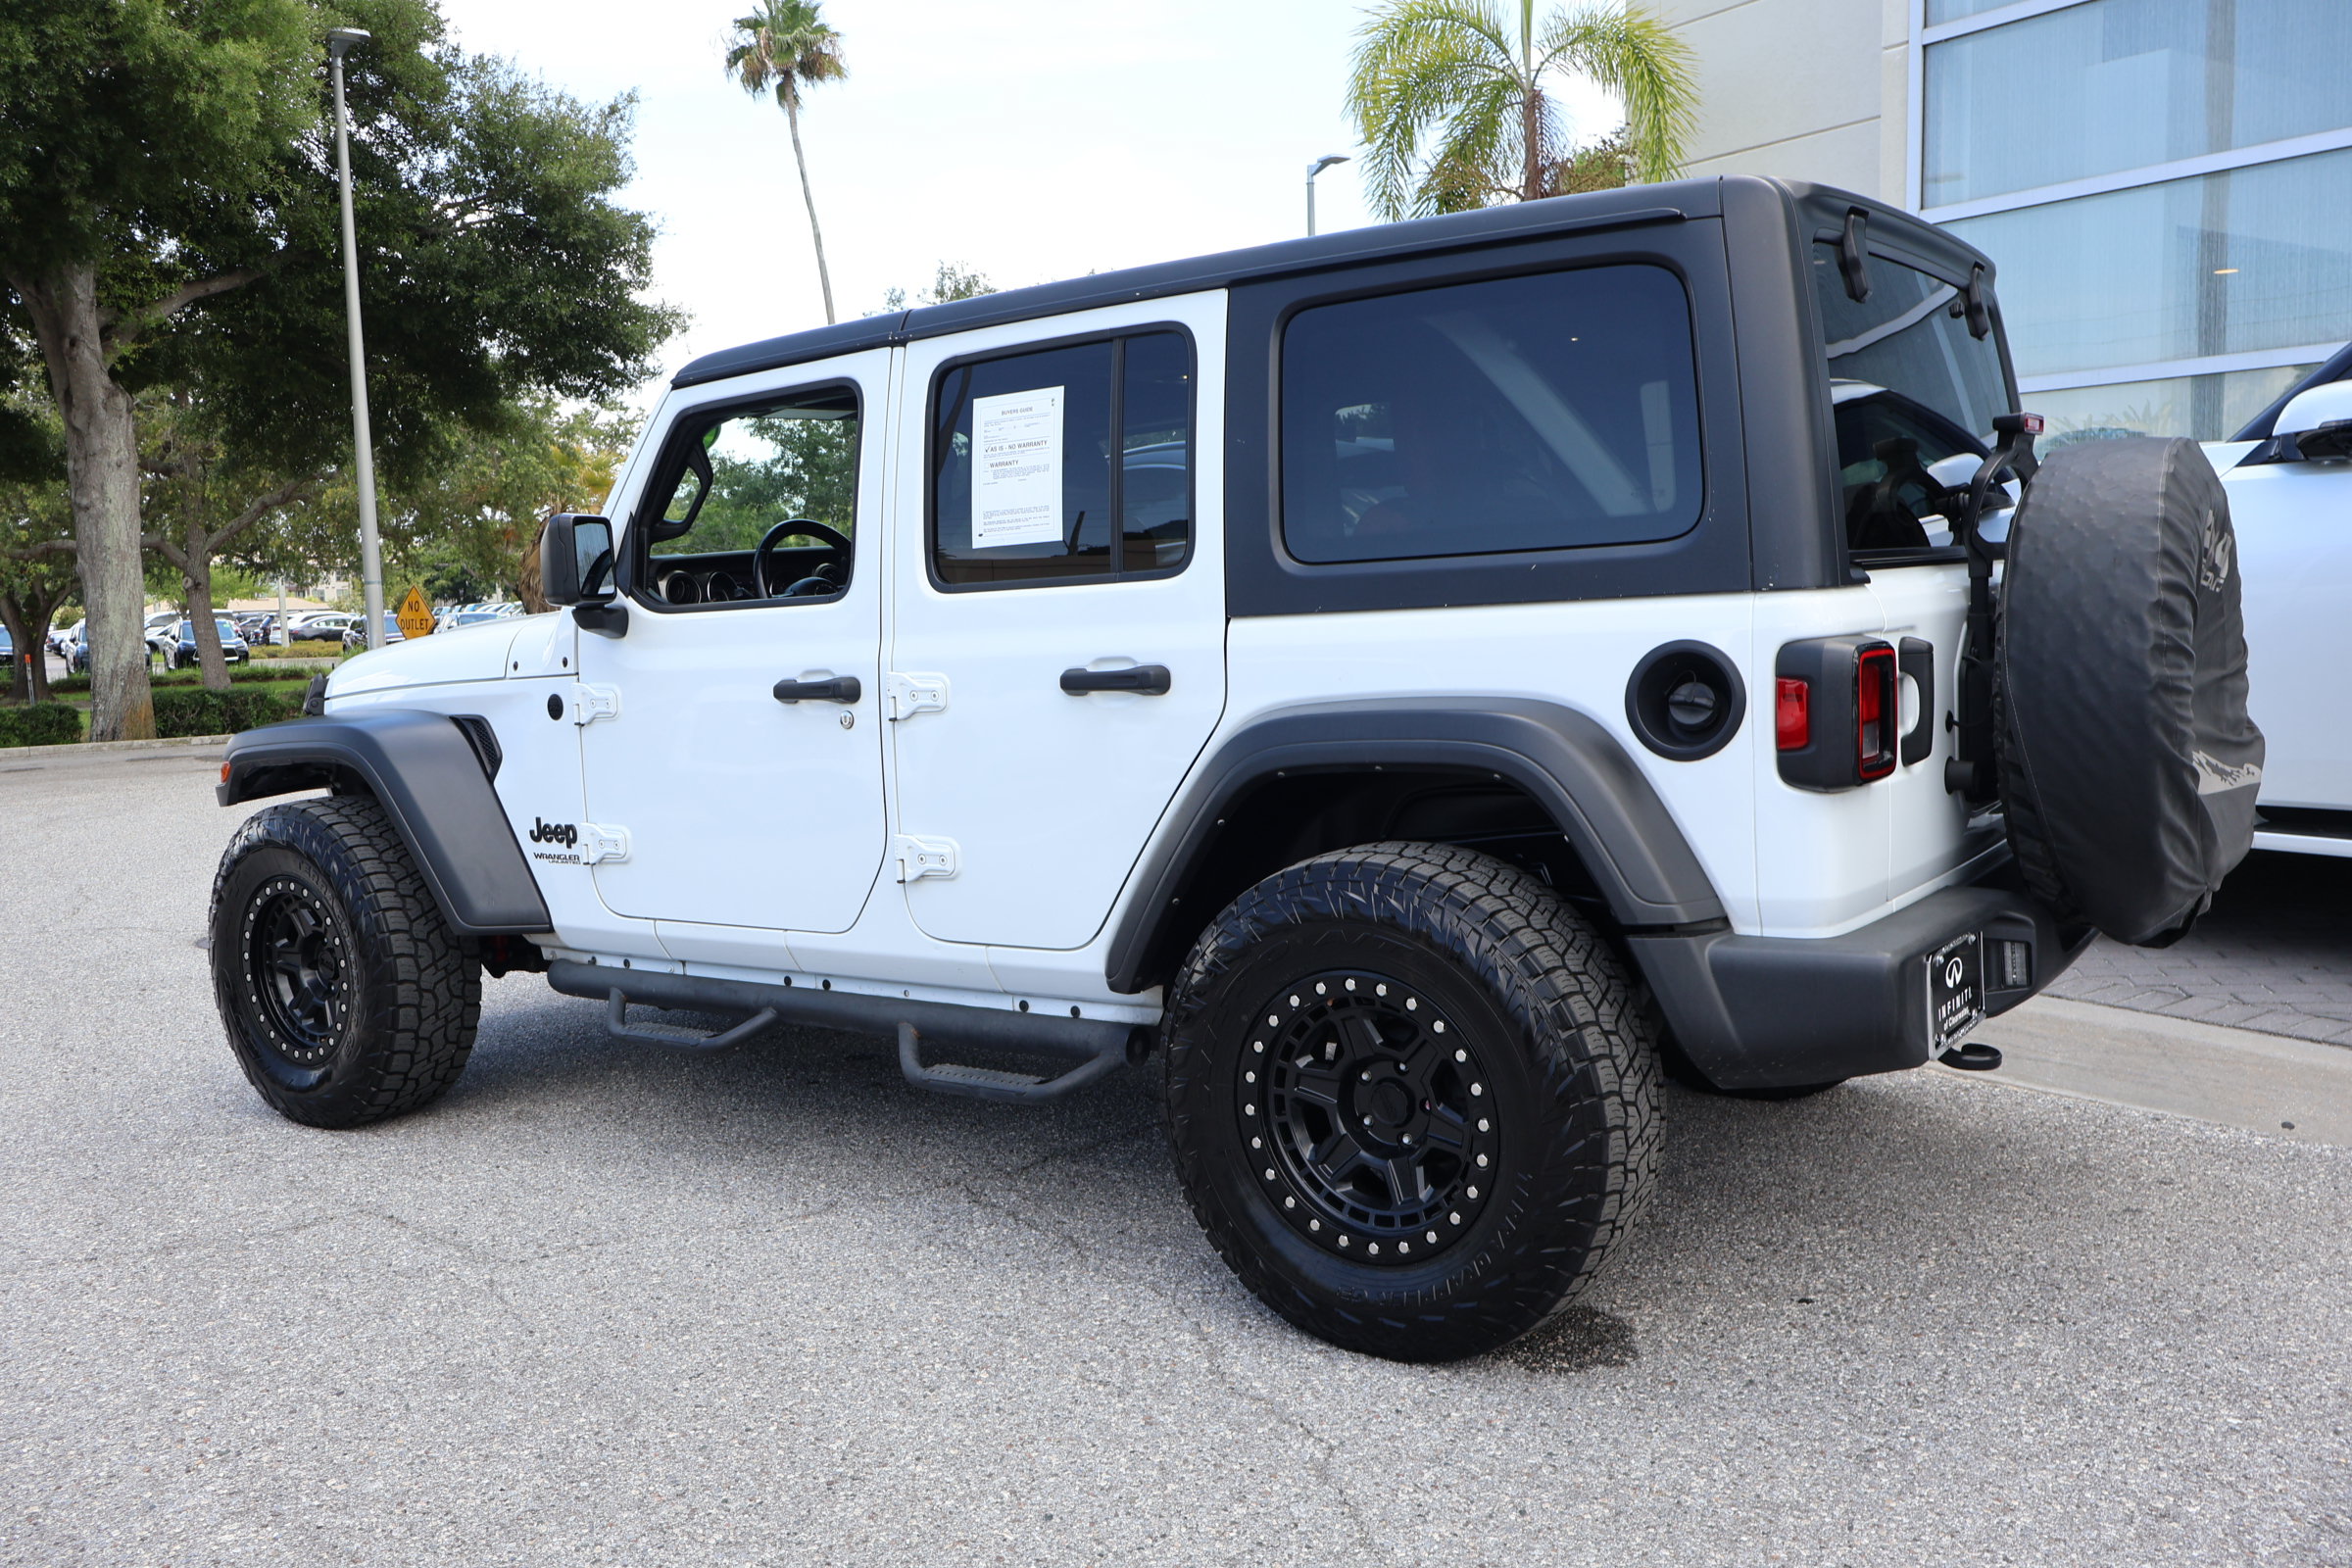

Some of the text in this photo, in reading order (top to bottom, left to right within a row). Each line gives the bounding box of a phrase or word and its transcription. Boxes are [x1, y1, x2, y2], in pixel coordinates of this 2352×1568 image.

[1018, 440, 1047, 449] WARRANTY
[990, 459, 1019, 468] WARRANTY
[408, 601, 420, 612] NO
[400, 619, 429, 630] OUTLET
[529, 816, 578, 849] Jeep
[533, 852, 580, 861] WRANGLER
[1938, 985, 1973, 1022] INFINITI
